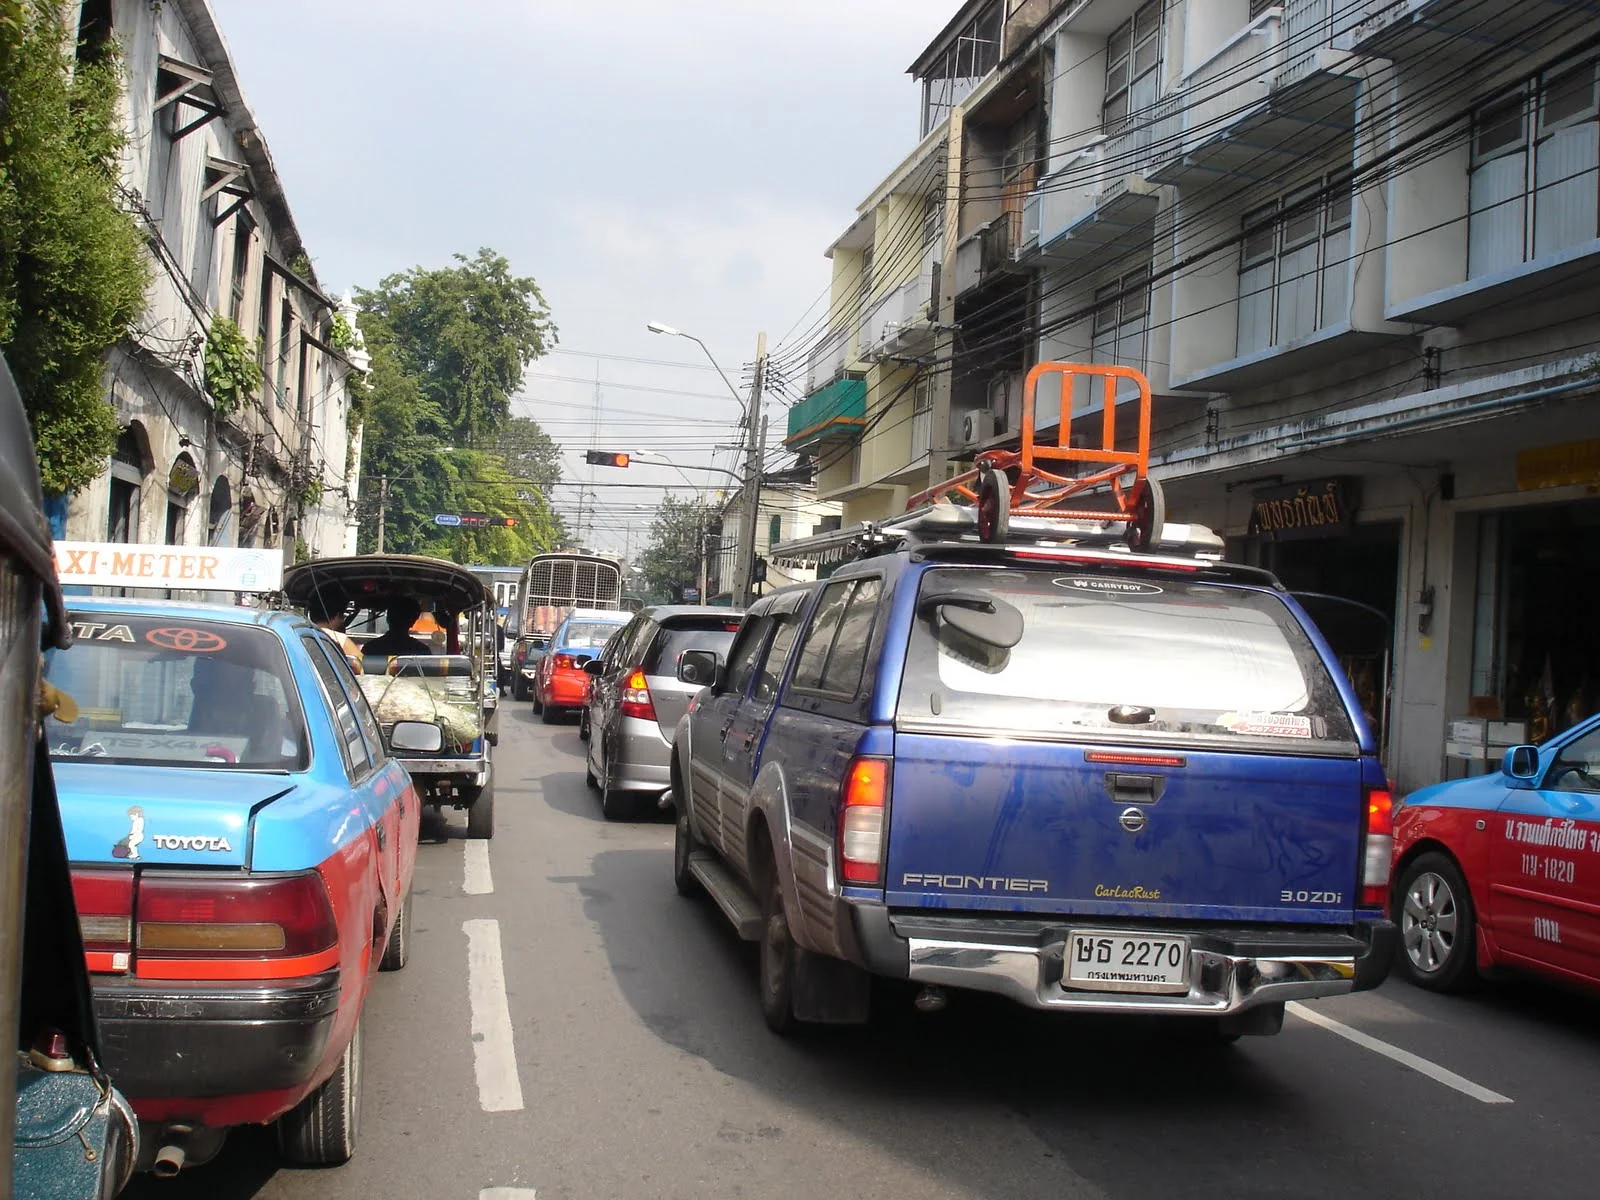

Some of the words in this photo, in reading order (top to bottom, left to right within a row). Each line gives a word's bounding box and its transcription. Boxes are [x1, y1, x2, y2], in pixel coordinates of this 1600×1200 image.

[1091, 581, 1141, 591] CARRYBOY
[153, 834, 232, 852] TOYOTA
[902, 873, 1049, 892] FRONTIER
[1121, 940, 1181, 968] 2270
